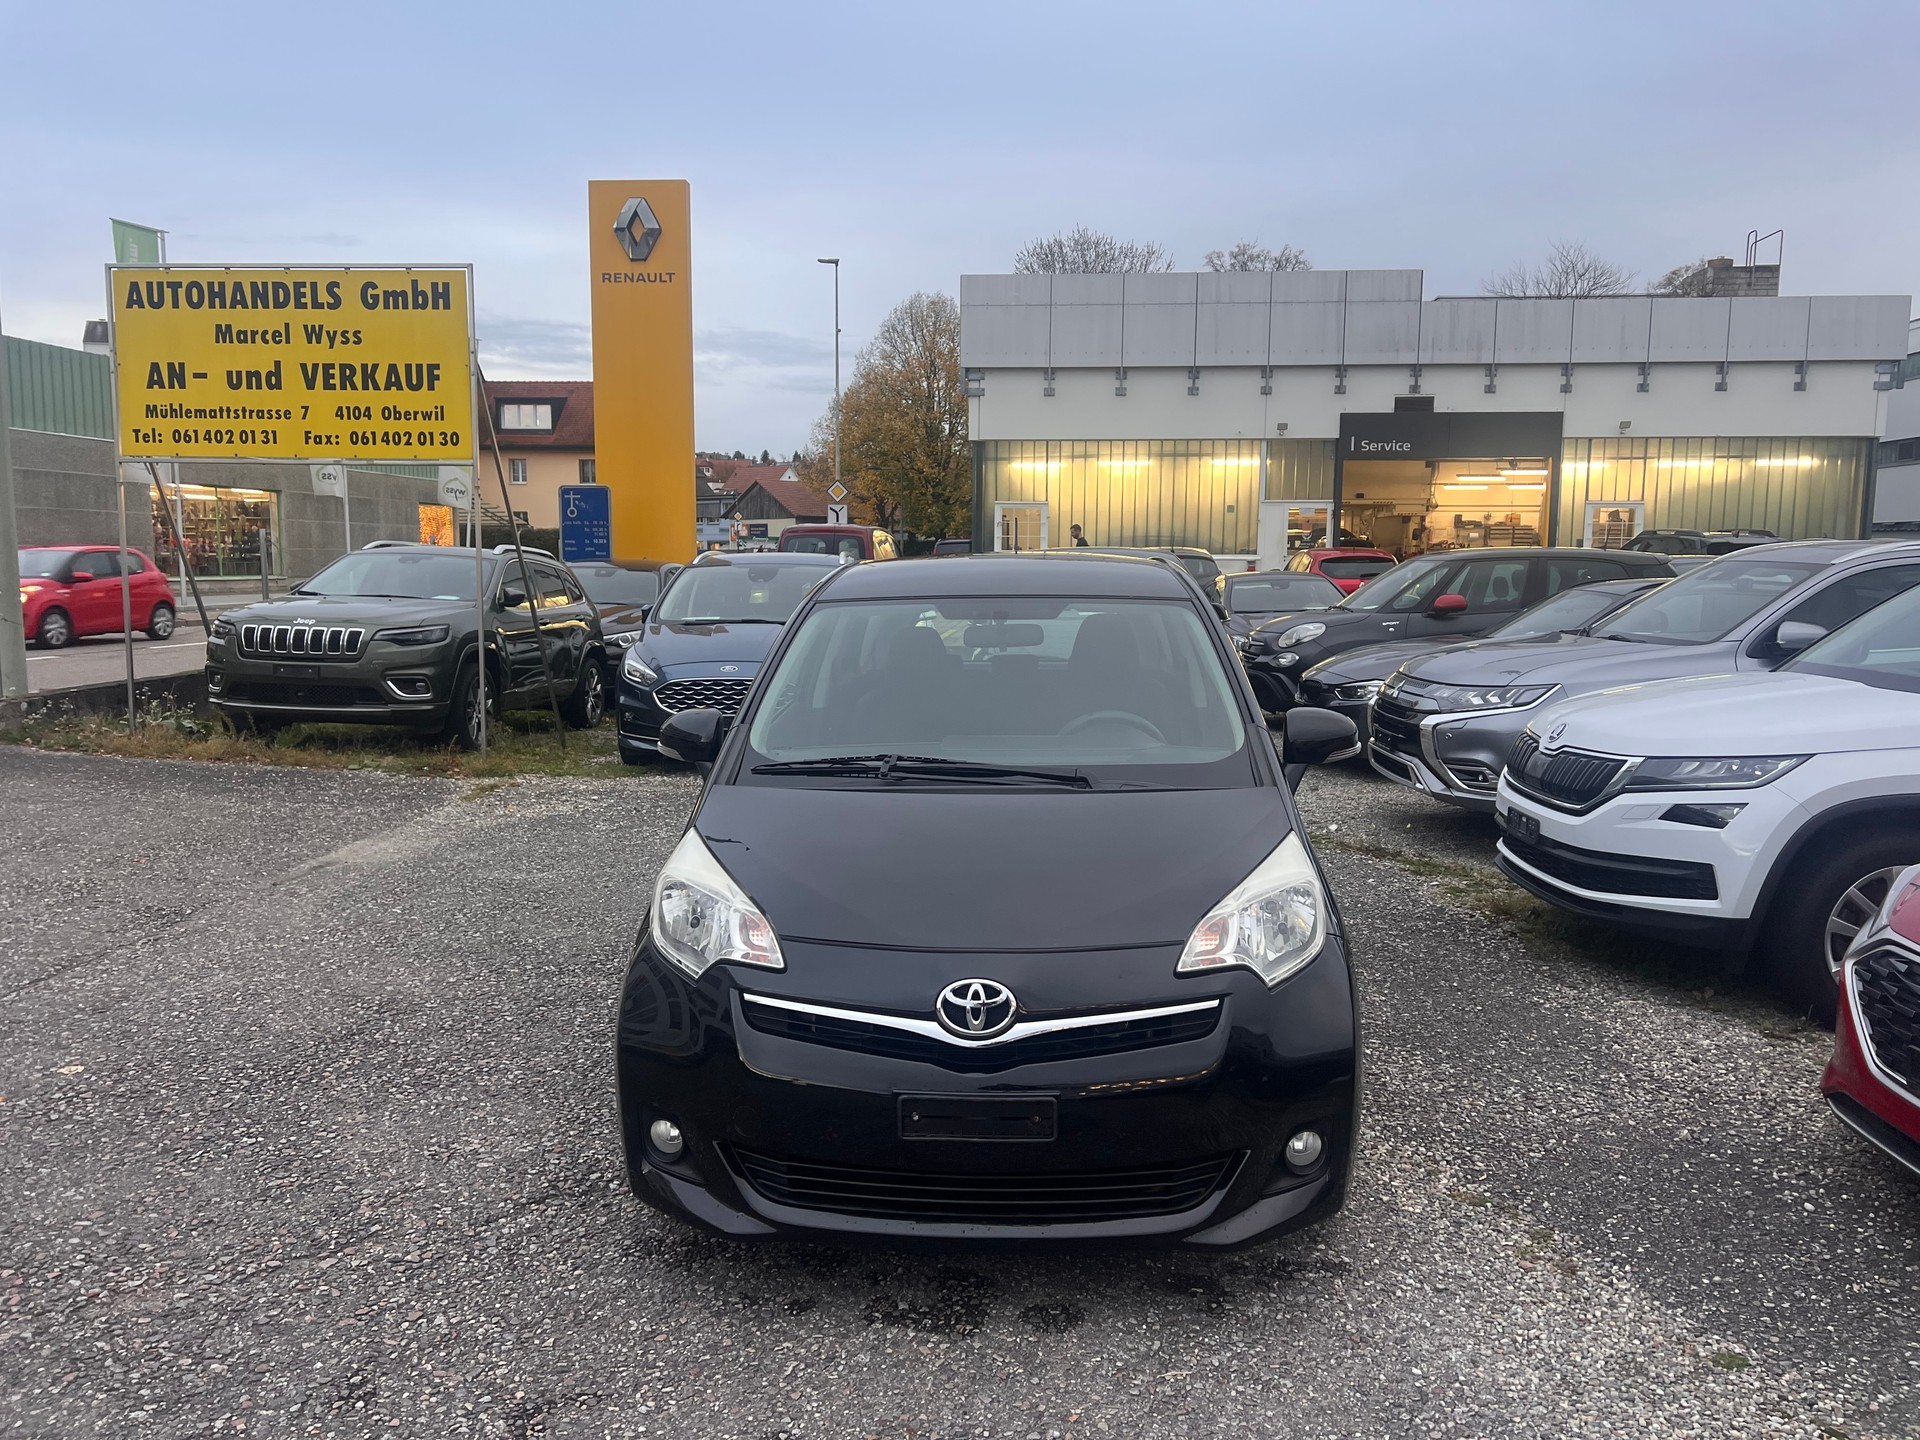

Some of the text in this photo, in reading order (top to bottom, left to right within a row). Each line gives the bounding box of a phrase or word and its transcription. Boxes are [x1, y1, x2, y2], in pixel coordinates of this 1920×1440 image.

[601, 271, 676, 283] RENAULT
[125, 278, 451, 311] AUTOHANDELS GmbH
[214, 322, 363, 350] Marcel Wyss
[225, 359, 283, 391] und
[299, 362, 441, 392] VERKAUF
[145, 402, 445, 422] Mühlemattstrasse 7 4104 Oberwil
[132, 427, 163, 444] Tel:
[304, 430, 340, 446] Fax:
[1361, 440, 1411, 451] Service
[292, 617, 316, 625] Jeep
